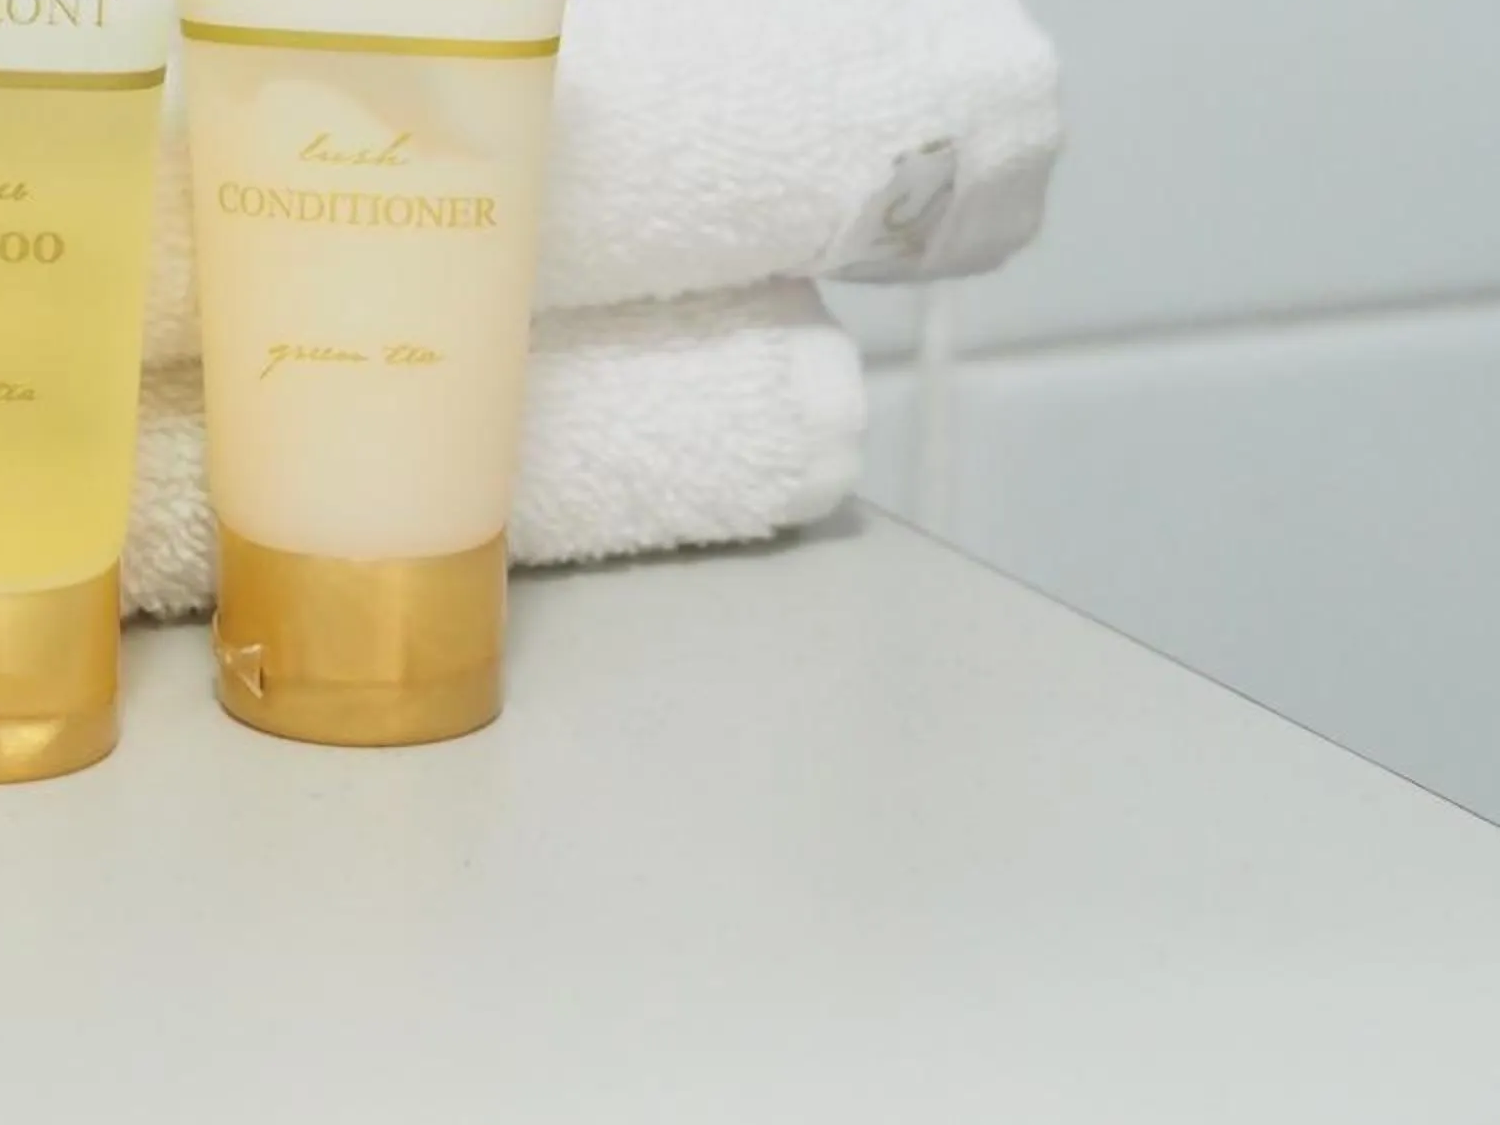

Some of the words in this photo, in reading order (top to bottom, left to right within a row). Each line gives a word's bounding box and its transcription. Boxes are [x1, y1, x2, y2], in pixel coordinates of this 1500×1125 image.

[218, 181, 498, 228] CONDITIONER
[260, 343, 369, 381] green
[382, 345, 444, 365] tea
